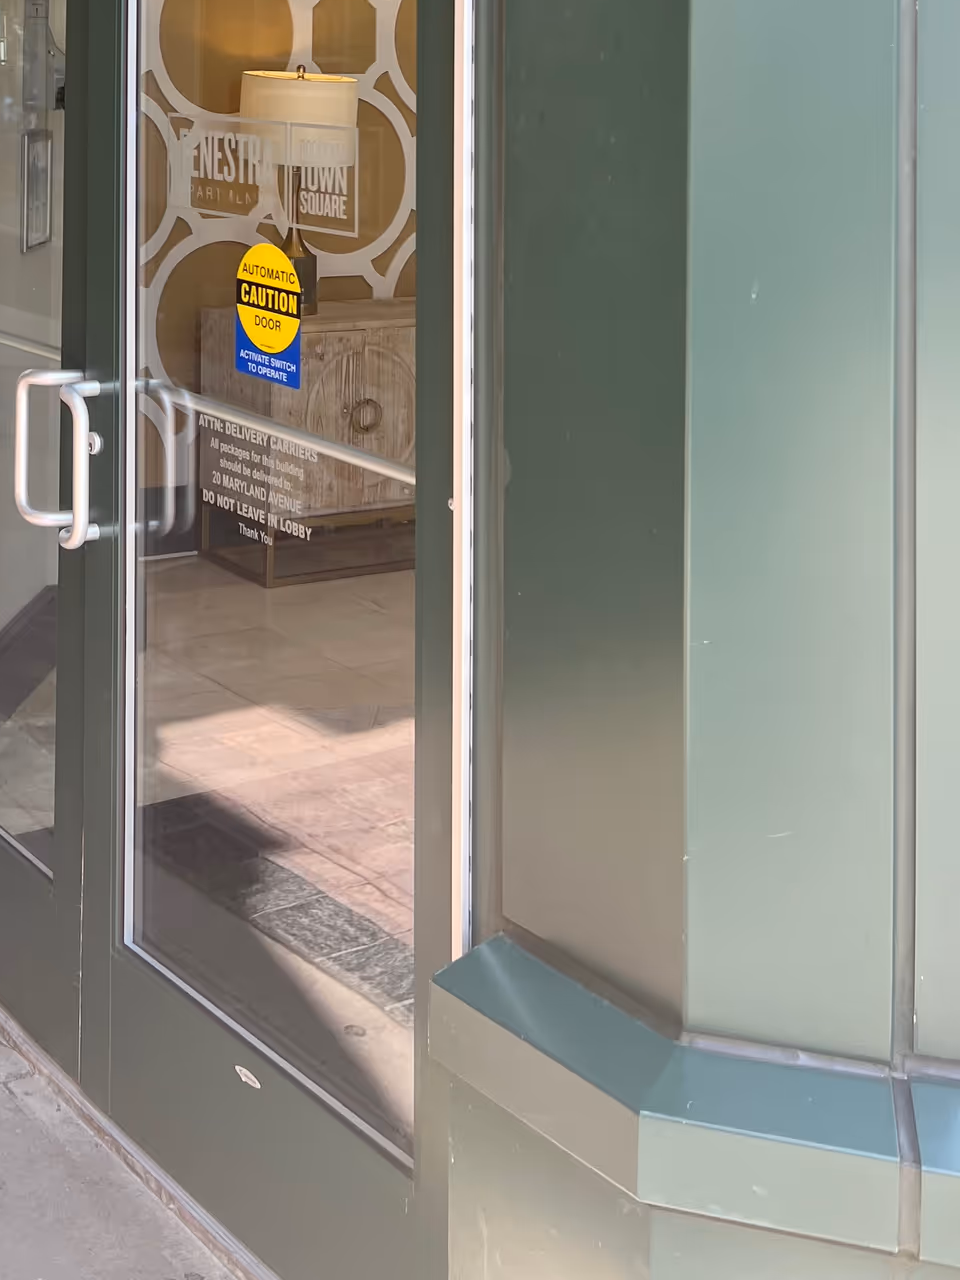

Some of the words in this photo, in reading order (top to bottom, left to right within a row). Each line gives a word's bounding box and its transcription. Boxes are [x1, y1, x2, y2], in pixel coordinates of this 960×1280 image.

[300, 191, 348, 219] SQUARE
[242, 262, 296, 285] AUTOMATIC
[241, 283, 298, 315] CAUTION
[254, 314, 282, 332] DOOR
[240, 349, 270, 366] ACTIVATE
[270, 357, 297, 373] SWITCH
[248, 362, 257, 373] TO
[257, 365, 288, 382] OPERATE
[199, 413, 224, 433] ATTN:
[225, 421, 269, 447] DELIVERY
[269, 435, 318, 463] CARRIERS
[210, 437, 219, 450] All
[220, 442, 250, 460] packages
[251, 451, 261, 463] for
[262, 455, 275, 469] this
[276, 459, 304, 481] building
[220, 458, 242, 474] should
[242, 463, 251, 476] be
[252, 469, 283, 488] delivered
[283, 478, 293, 492] to:
[212, 470, 221, 485] 20
[222, 474, 267, 501] MARYLAND
[268, 490, 302, 514] AVENUE
[202, 488, 215, 505] DO
[216, 493, 235, 513] NOT
[237, 500, 266, 524] LEAVE
[267, 512, 278, 530] IN
[280, 518, 312, 542] LOBBY
[239, 522, 259, 540] Thank
[260, 530, 273, 546] You
